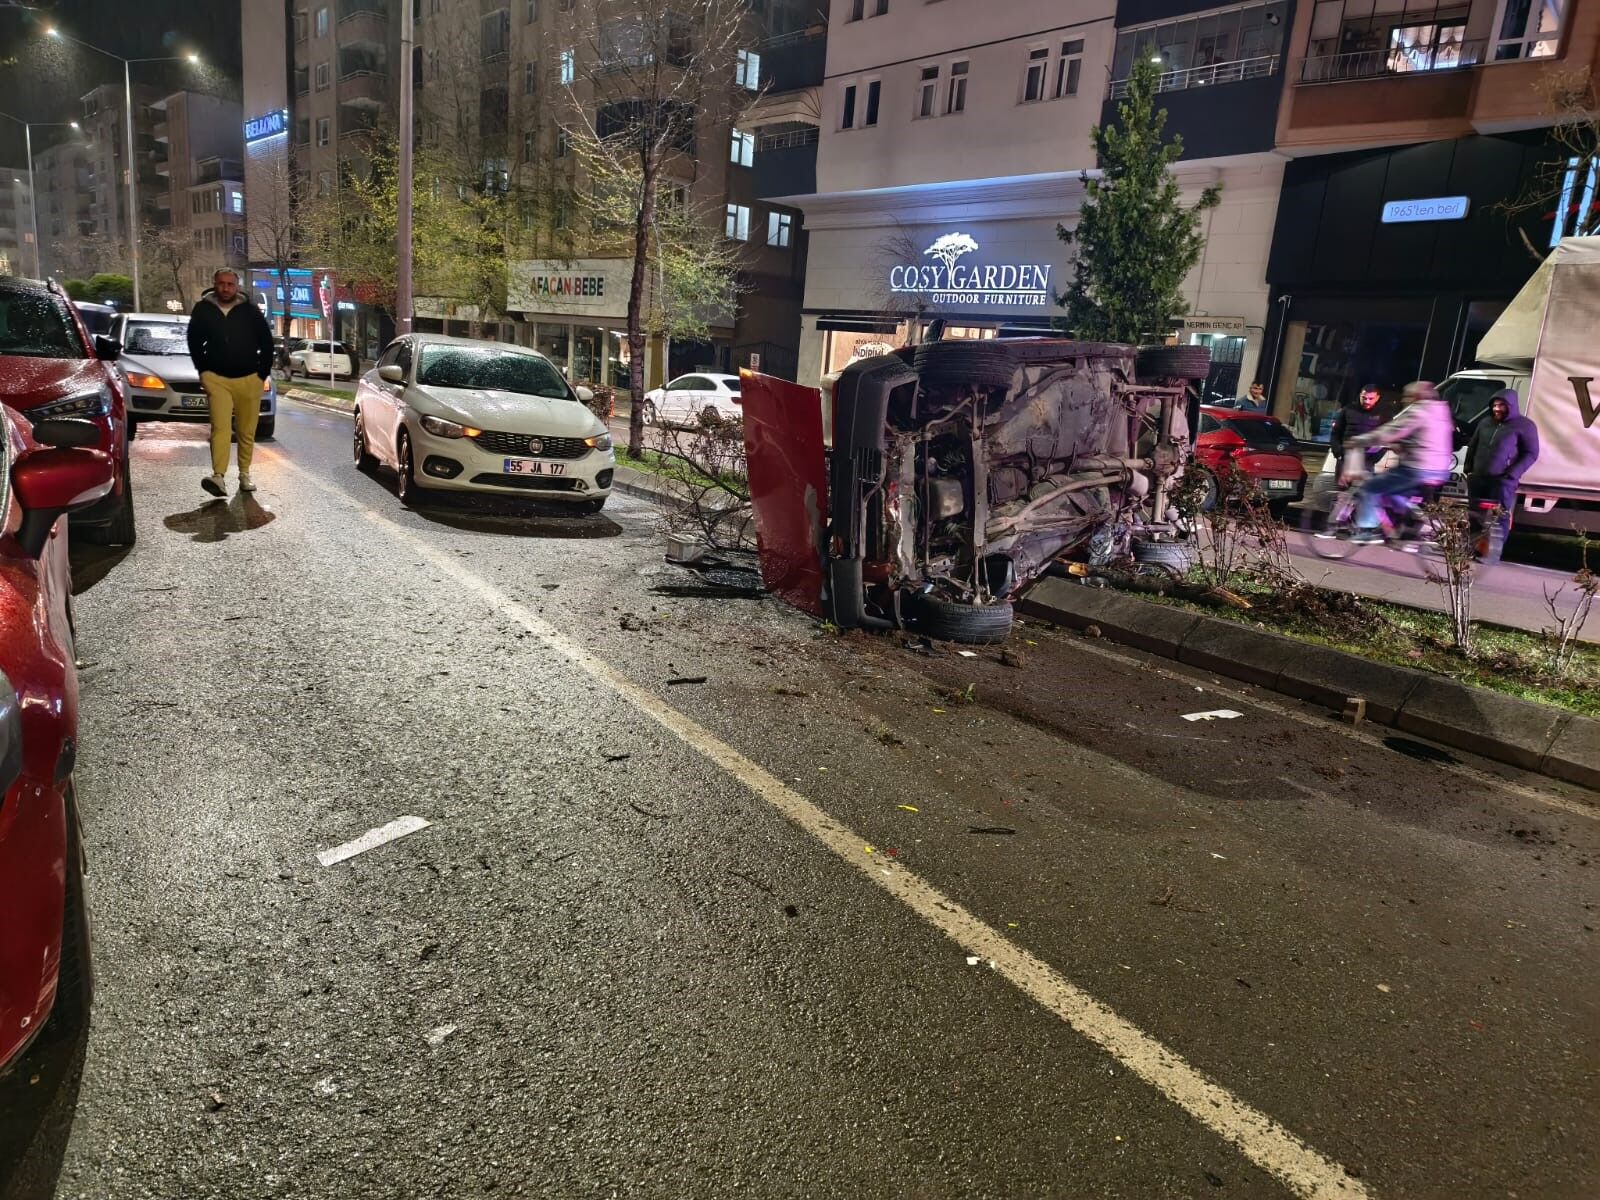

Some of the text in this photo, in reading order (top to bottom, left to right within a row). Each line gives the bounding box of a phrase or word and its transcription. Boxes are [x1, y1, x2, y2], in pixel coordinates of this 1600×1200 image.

[245, 114, 281, 139] BELLONA
[574, 276, 604, 297] BEBE
[890, 264, 1052, 290] COSY GARDEN
[932, 292, 1046, 305] OUTDOOR FURNITURE
[511, 461, 565, 474] 55 JA 177
